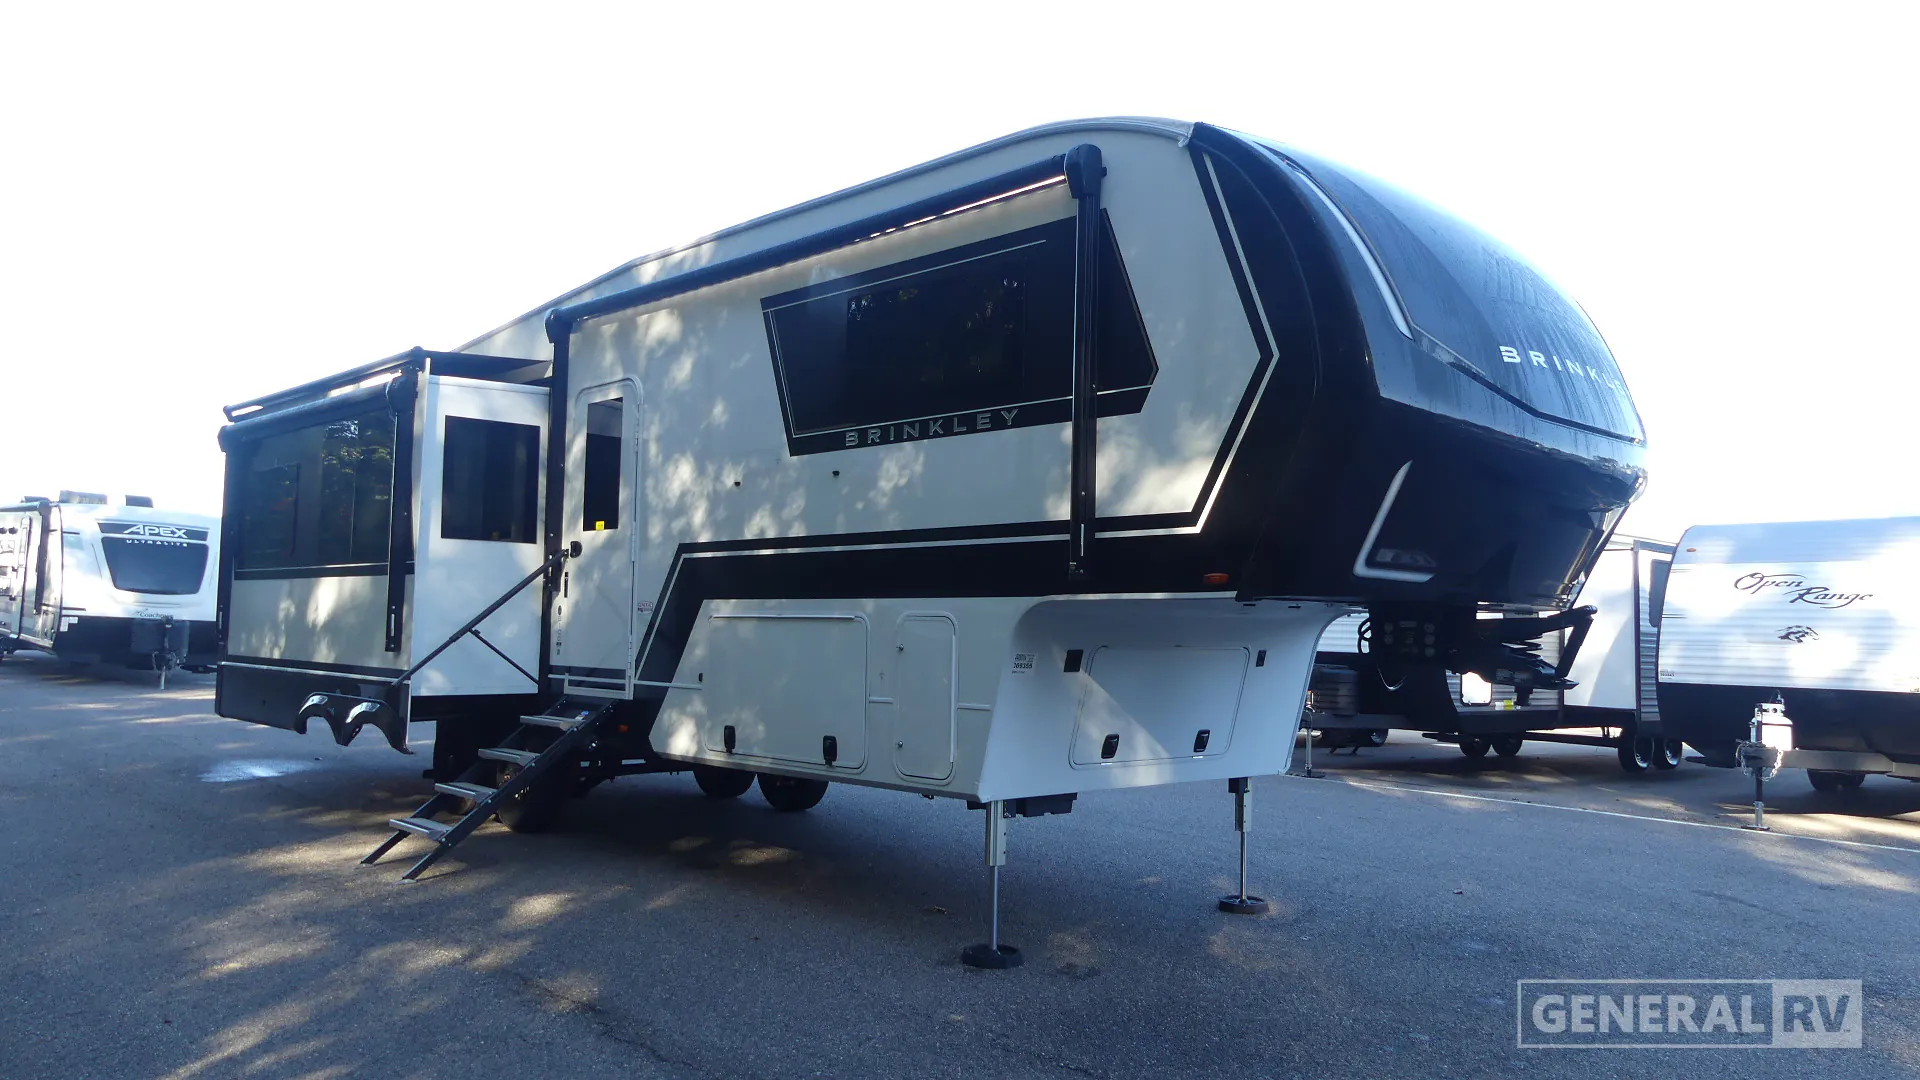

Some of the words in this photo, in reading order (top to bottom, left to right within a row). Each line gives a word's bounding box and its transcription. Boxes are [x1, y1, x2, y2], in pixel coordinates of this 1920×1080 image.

[845, 408, 1019, 447] BRINKLEY
[123, 524, 188, 539] APEX
[126, 538, 188, 548] ULTRALITE
[1733, 572, 1807, 595] Open
[1782, 586, 1874, 609] Range
